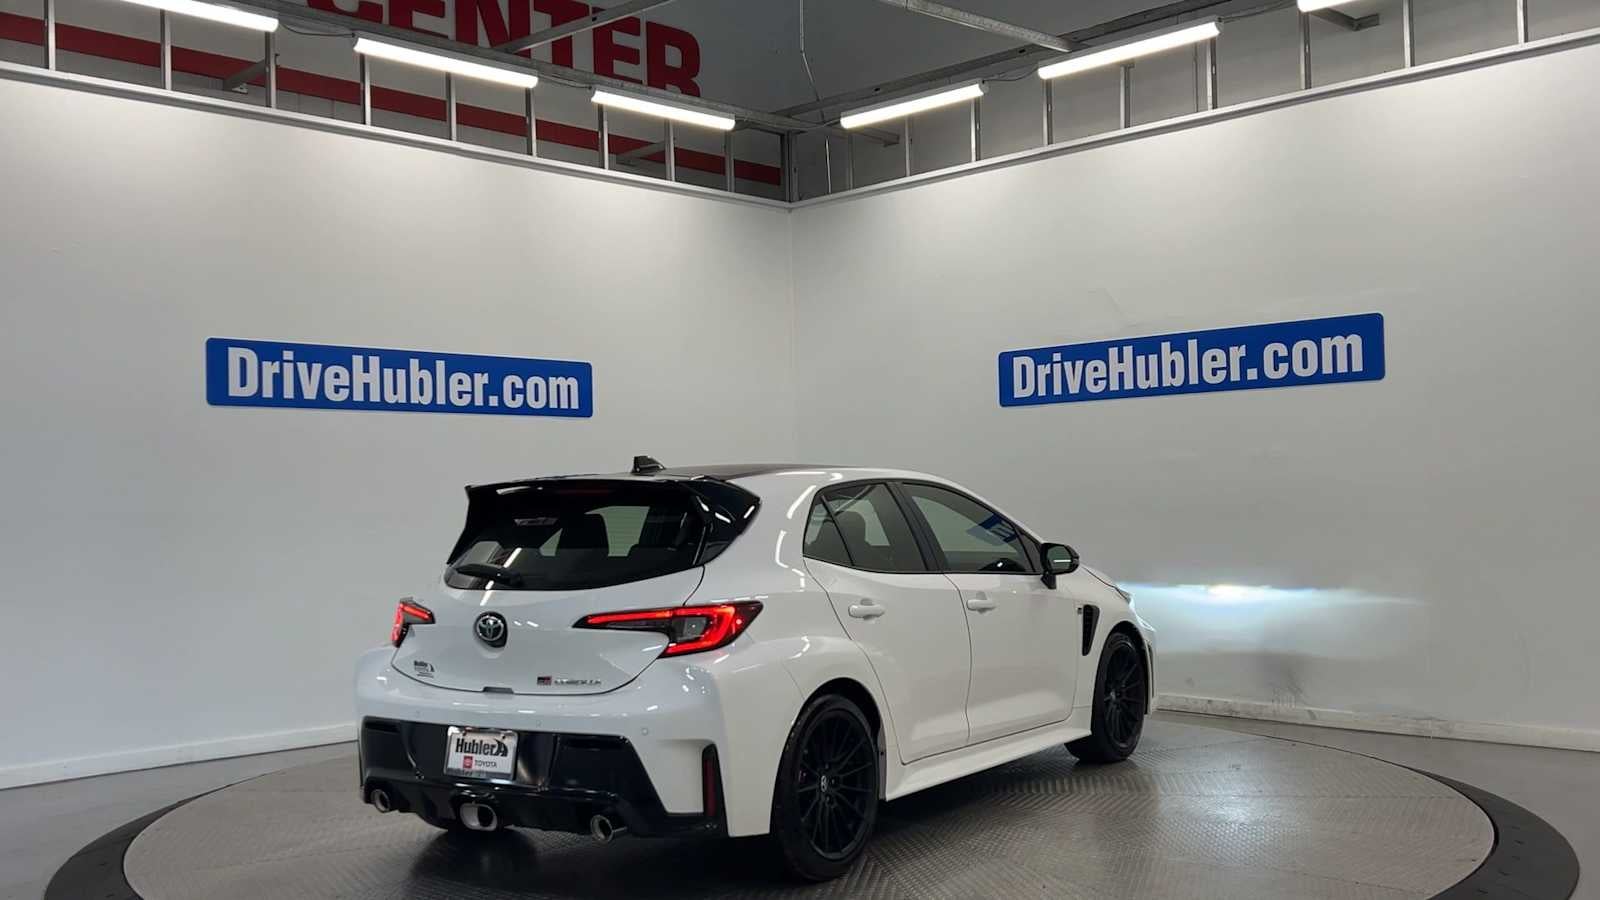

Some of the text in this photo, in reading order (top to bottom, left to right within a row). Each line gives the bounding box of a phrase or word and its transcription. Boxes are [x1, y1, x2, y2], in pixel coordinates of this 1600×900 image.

[227, 346, 579, 409] DriveHubler.com
[1013, 333, 1364, 399] DriveHubler.com
[455, 738, 497, 756] Hubler
[475, 760, 497, 768] TOYOTA
